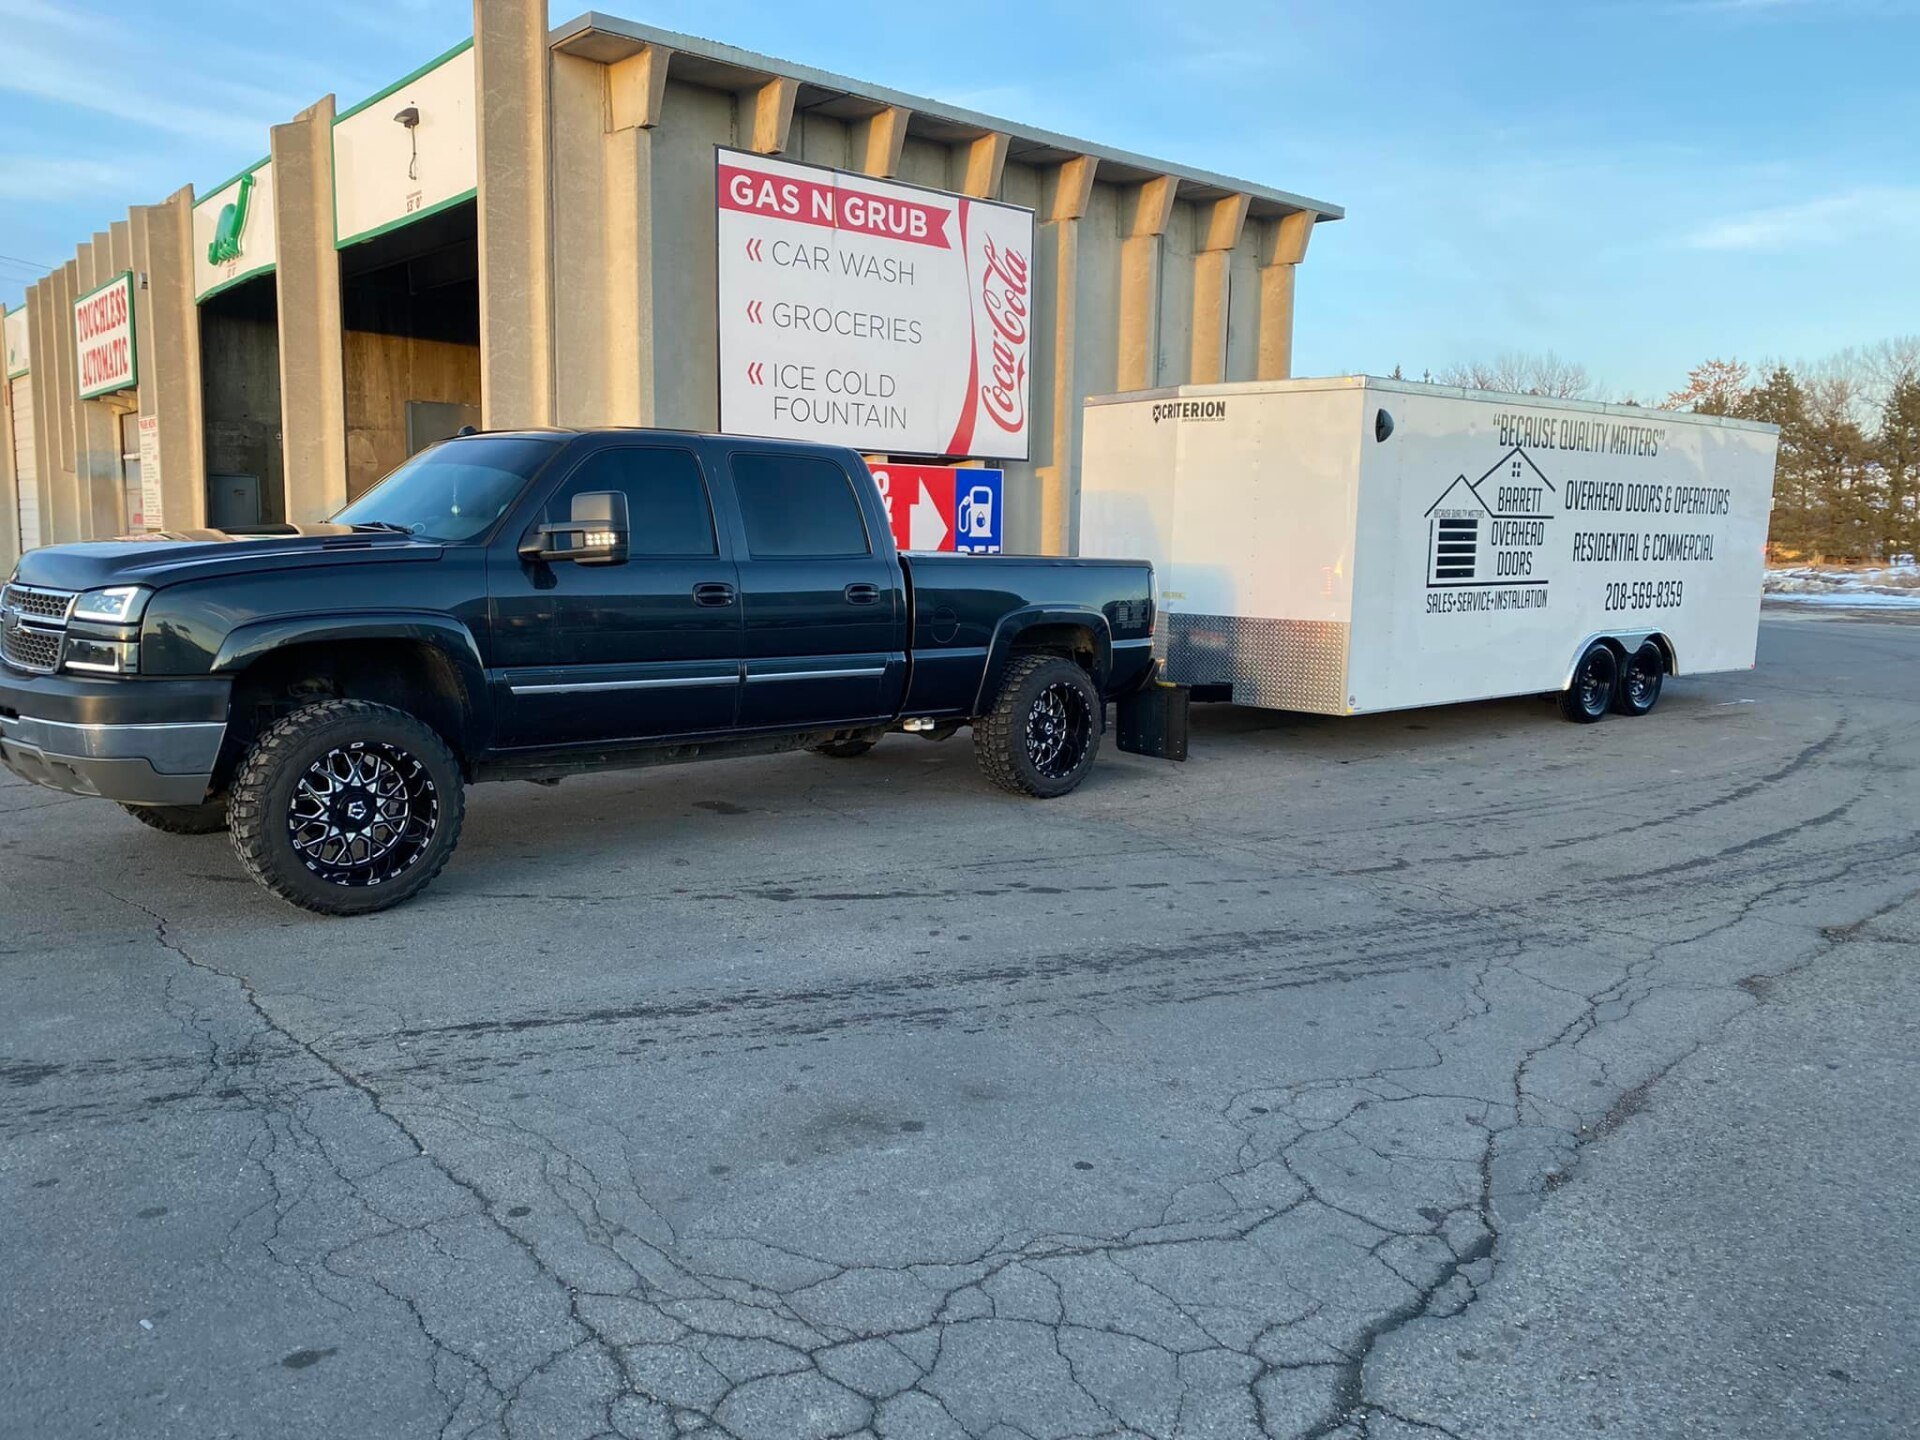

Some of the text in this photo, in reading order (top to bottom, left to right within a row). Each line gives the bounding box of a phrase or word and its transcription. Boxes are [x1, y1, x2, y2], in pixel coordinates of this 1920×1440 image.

[729, 174, 928, 238] GAS N GRUB
[771, 240, 915, 286] CAR WASH
[77, 284, 127, 342] TOUCHLESS
[772, 302, 922, 344] GROCERIES
[981, 231, 1028, 434] Coca-Cola
[82, 336, 128, 387] AUTOMATIC
[774, 363, 896, 398] ICE COLD
[774, 396, 907, 430] FOUNTAIN
[1162, 401, 1226, 419] CRITERION
[1560, 420, 1608, 453] QUALITY
[1498, 486, 1543, 513] BARRETT
[1565, 479, 1731, 515] OVERHEAD DOORS & OPERATORS
[1490, 520, 1544, 546] OVERHEAD
[1573, 532, 1714, 562] RESIDENTIAL & COMMERCIAL
[1497, 551, 1532, 577] DOORS
[1605, 580, 1683, 611] 208-569-8359
